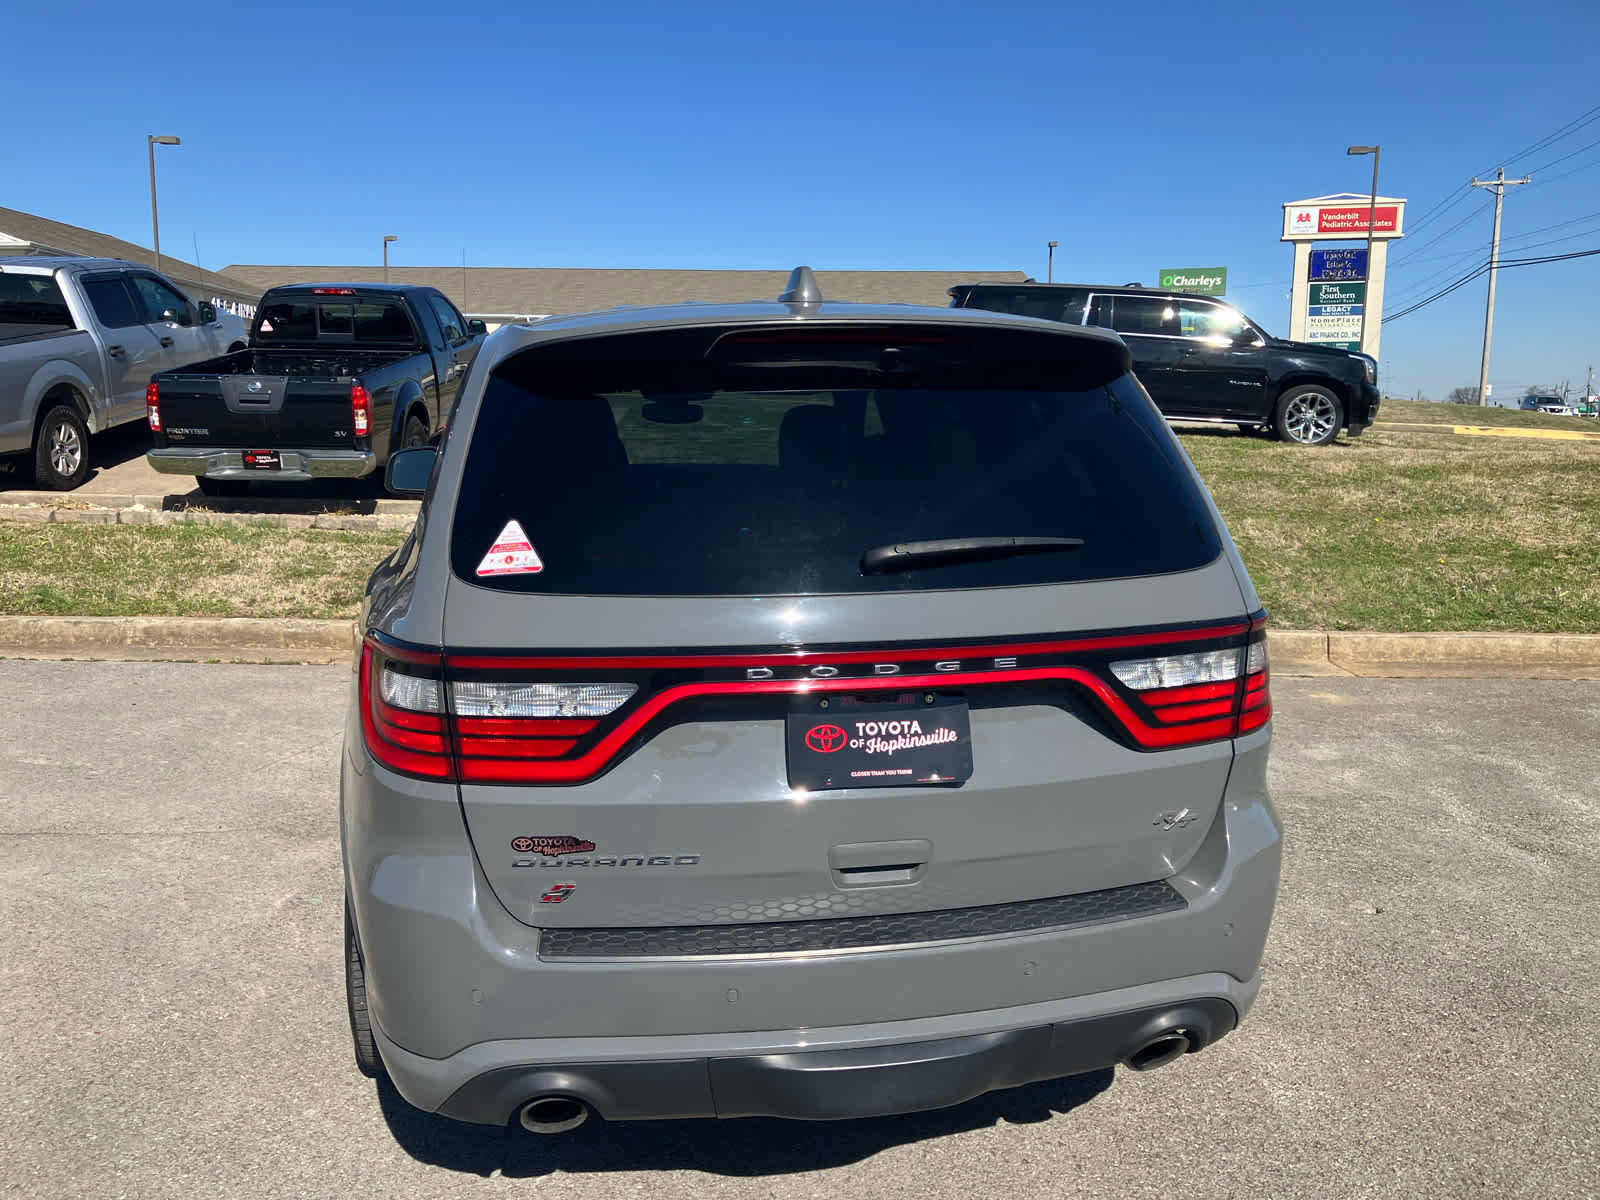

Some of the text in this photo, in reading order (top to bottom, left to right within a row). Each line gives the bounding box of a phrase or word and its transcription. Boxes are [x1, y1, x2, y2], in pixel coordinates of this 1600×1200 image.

[1321, 219, 1392, 228] Pediatric Assoiates
[1322, 284, 1340, 293] First
[1320, 291, 1356, 299] Southern
[334, 430, 347, 438] SV
[747, 657, 1017, 679] DODGE
[855, 720, 922, 736] TOYOTA
[849, 727, 958, 756] OF Hopkinsville
[511, 853, 701, 868] DURANGO
